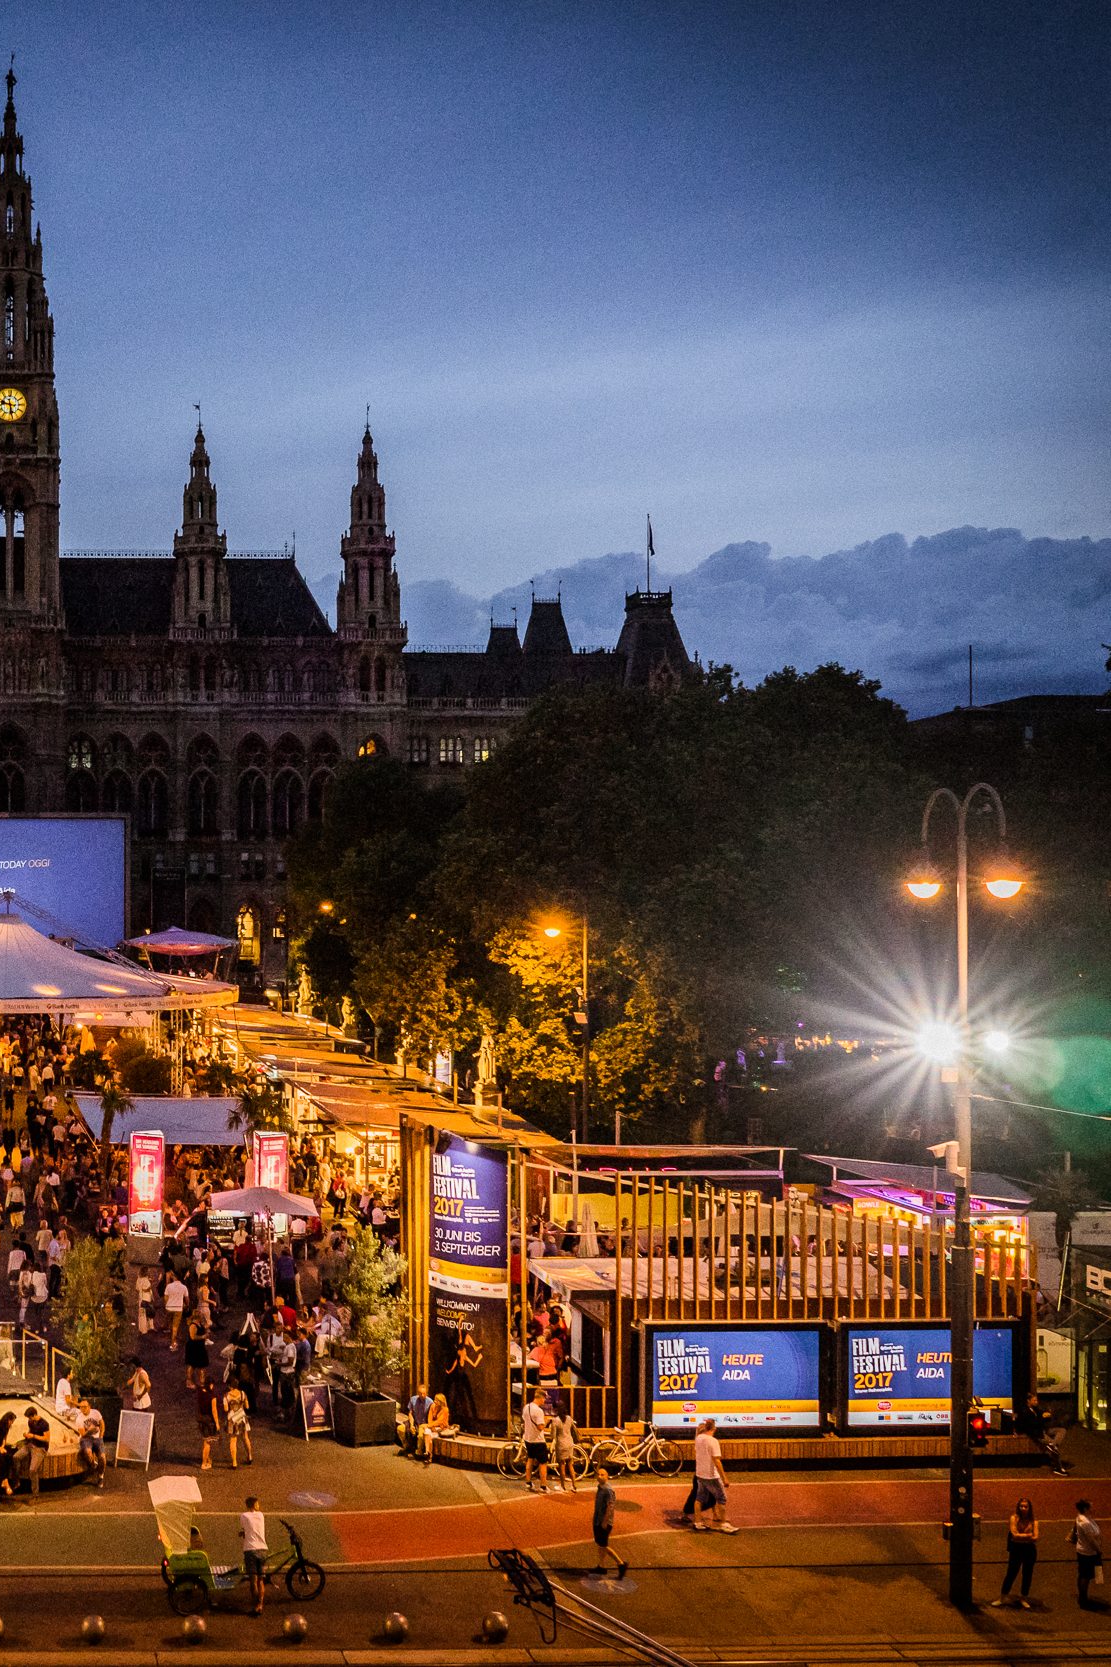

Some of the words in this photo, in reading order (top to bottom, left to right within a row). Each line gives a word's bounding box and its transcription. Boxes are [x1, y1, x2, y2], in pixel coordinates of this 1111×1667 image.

[0, 860, 28, 869] TODAY
[28, 858, 50, 868] OGGI
[432, 1154, 452, 1176] FILM
[434, 1176, 480, 1200] FESTIVAL
[434, 1196, 464, 1216] 2017
[434, 1227, 444, 1238] 30.
[445, 1230, 462, 1242] JUNI
[464, 1232, 482, 1242] BIS
[434, 1240, 440, 1252] 3.
[441, 1242, 501, 1256] SEPTEMBER
[656, 1338, 686, 1358] FILM
[852, 1338, 880, 1356] FILM
[658, 1356, 712, 1376] FESTIVAL
[722, 1354, 764, 1366] HEUTE
[852, 1354, 908, 1374] FESTIVAL
[722, 1370, 750, 1380] AIDA
[854, 1372, 894, 1388] 2017
[916, 1368, 945, 1378] AIDA
[658, 1374, 699, 1390] 2017
